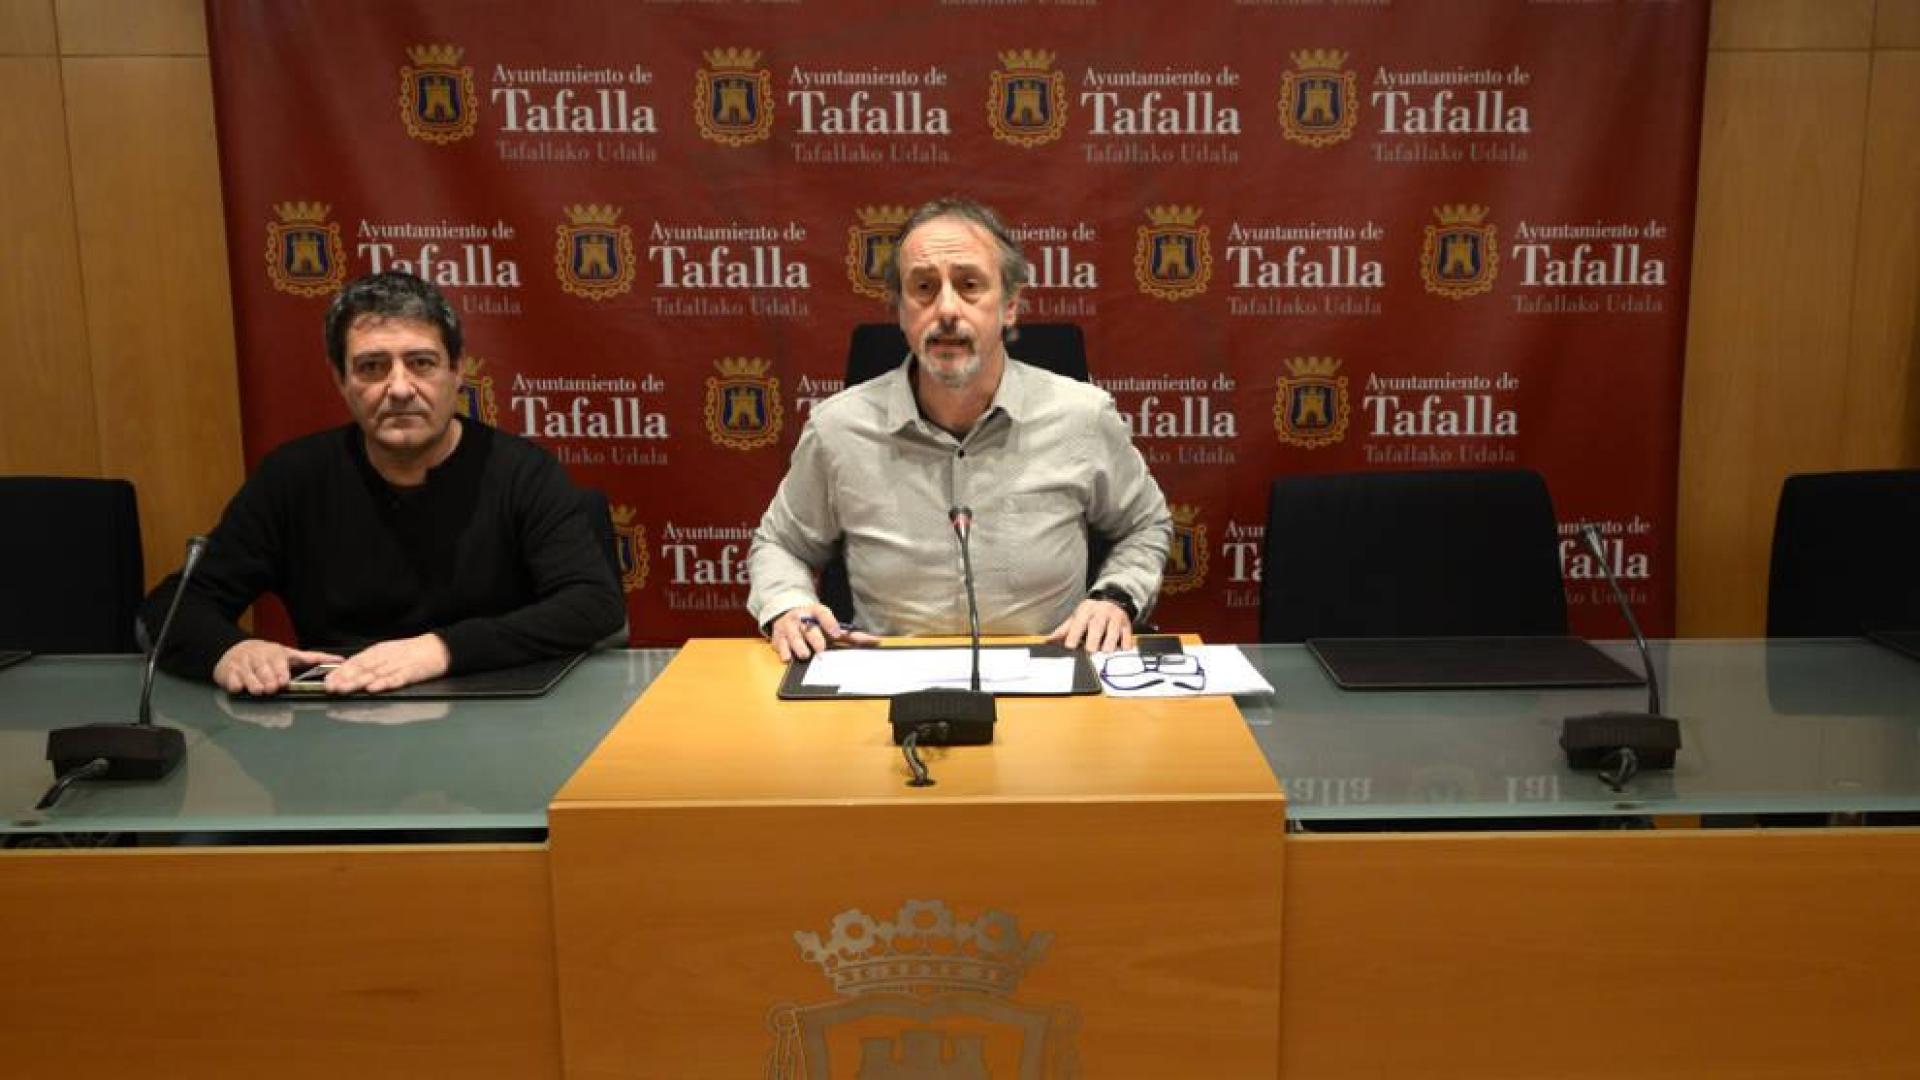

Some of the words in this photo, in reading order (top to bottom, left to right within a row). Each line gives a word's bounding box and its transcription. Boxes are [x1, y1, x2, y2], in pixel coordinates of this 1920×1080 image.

[493, 64, 623, 86] Ayuntamiento
[629, 64, 652, 83] de
[790, 65, 918, 88] Ayuntamiento
[924, 65, 947, 85] de
[1083, 66, 1211, 89] Ayuntamiento
[1216, 66, 1239, 86] de
[1373, 65, 1503, 89] Ayuntamiento
[1508, 65, 1530, 85] de
[492, 88, 658, 132] Tafalla
[788, 91, 952, 134] Tafalla
[1080, 91, 1241, 134] Tafalla
[1371, 91, 1531, 133] Tafalla
[497, 140, 589, 161] Tafallako
[597, 140, 657, 161] Udala
[791, 143, 882, 162] Tafallako
[891, 143, 950, 162] Udala
[1083, 143, 1174, 162] Tafallako
[1181, 143, 1239, 162] Udala
[1373, 142, 1463, 161] Tafallako
[1471, 142, 1529, 161] Udala
[358, 219, 488, 242] Ayuntamiento
[493, 219, 515, 239] de
[650, 220, 778, 244] Ayuntamiento
[783, 221, 806, 240] de
[1006, 223, 1067, 241] miento
[1072, 222, 1096, 241] de
[1227, 221, 1354, 244] Ayuntamiento
[1360, 220, 1384, 240] de
[1515, 220, 1639, 243] Ayuntamiento
[1644, 219, 1667, 238] de
[649, 246, 810, 287] Tafalla
[1225, 246, 1385, 287] Tafalla
[1512, 243, 1666, 286] Tafalla
[463, 294, 521, 313] Udala
[652, 296, 743, 315] Tafallako
[751, 296, 809, 315] Udala
[1039, 297, 1097, 316] Udala
[1228, 296, 1316, 315] Tafallako
[1325, 296, 1382, 314] Udala
[1512, 294, 1598, 312] Tafallako
[1607, 294, 1663, 312] Udala
[512, 373, 636, 395] Ayuntamiento
[642, 373, 664, 392] de
[1212, 372, 1236, 391] de
[1365, 372, 1490, 394] Ayuntamiento
[1496, 372, 1519, 390] de
[512, 396, 671, 438] Tafalla
[1363, 395, 1518, 435] Tafalla
[557, 447, 605, 464] llako
[612, 447, 668, 465] Udala
[1363, 444, 1452, 463] Tafallako
[1460, 444, 1515, 463] Udala
[1627, 516, 1650, 534] de
[661, 545, 751, 584] Tafa
[664, 589, 746, 609] Tafallak
